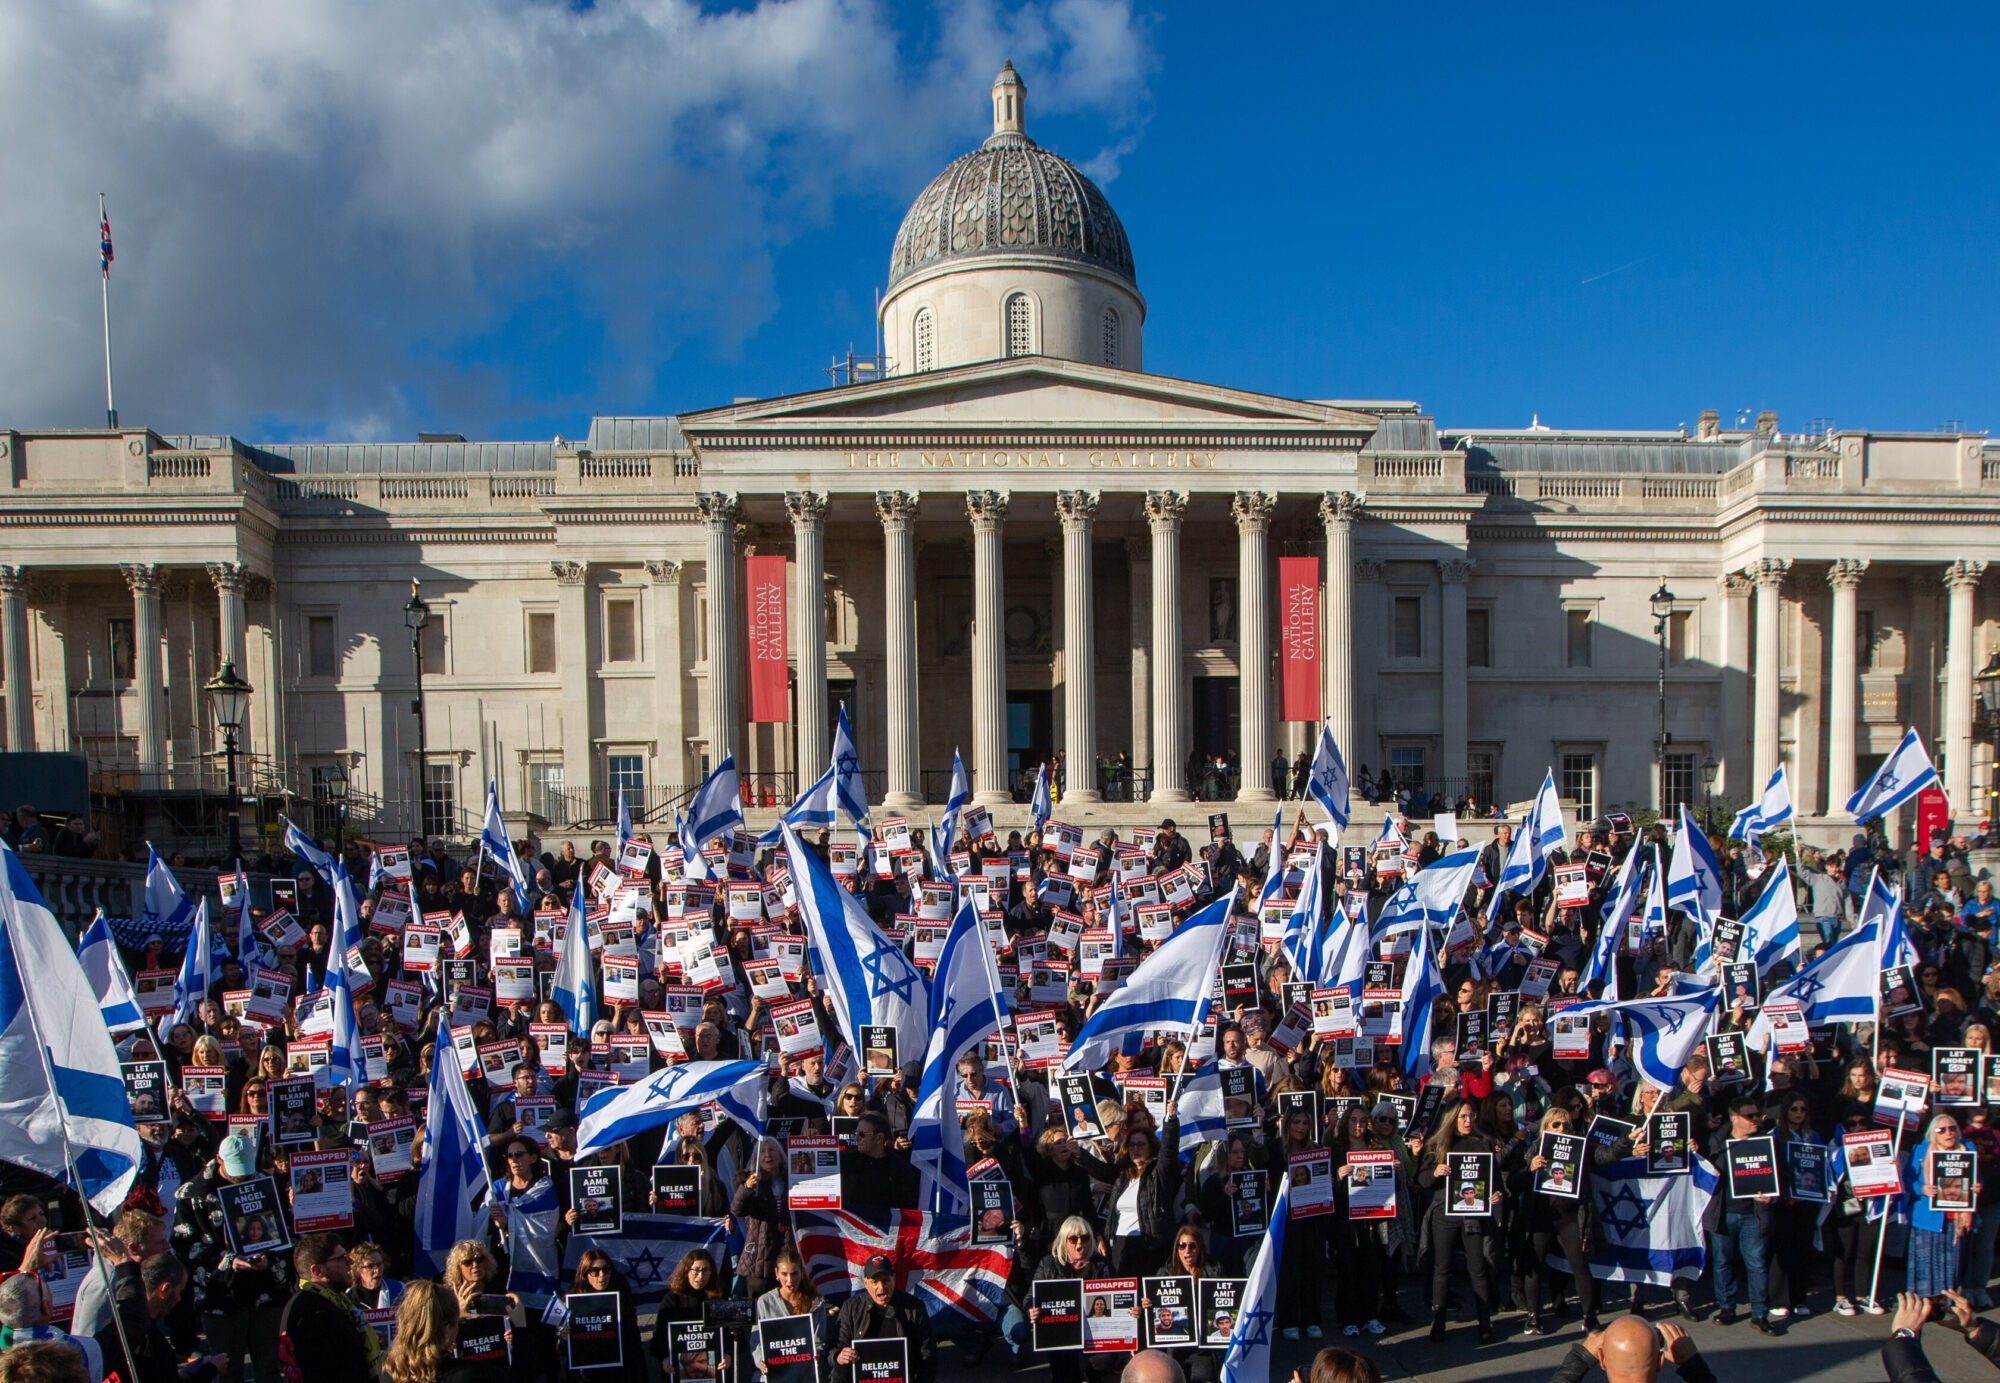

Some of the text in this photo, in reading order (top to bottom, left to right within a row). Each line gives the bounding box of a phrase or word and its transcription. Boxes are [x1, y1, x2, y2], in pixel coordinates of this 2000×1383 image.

[844, 451, 1218, 468] THE NATIONAL GALLERY
[756, 582, 768, 660] NATIONAL
[769, 583, 782, 661] GALLERY
[1290, 584, 1300, 660] NATIONAL
[1302, 584, 1314, 661] GALLERY
[1074, 847, 1099, 857] KIDNAPPED
[1160, 870, 1183, 884] KIDNAPPED
[1057, 912, 1084, 923] KIDNAPPED
[1522, 928, 1548, 942] KIDNAPPED
[1717, 926, 1739, 935] ELKANA
[605, 957, 637, 965] KIDNAPPED
[745, 960, 778, 969] KIDNAPPED
[258, 970, 290, 982] KIDNAPPED
[390, 980, 422, 992] KIDNAPPED
[460, 985, 491, 994] KIDNAPPED
[1312, 989, 1348, 998] KIDNAPPED
[773, 1002, 810, 1017] KIDNAPPED
[1018, 1013, 1053, 1023] KIDNAPPED
[480, 1042, 517, 1055] KIDNAPPED
[127, 1072, 158, 1080] ELKANA
[1885, 1069, 1928, 1084] KIDNAPPED
[1229, 1077, 1245, 1085] AMIT
[1067, 1085, 1083, 1094] ELIYA
[1231, 1085, 1245, 1093] GO!
[280, 1092, 310, 1101] ELKANA
[370, 1117, 412, 1131] KIDNAPPED
[1557, 1136, 1571, 1144] LET
[1846, 1133, 1888, 1143] KIDNAPPED
[1553, 1143, 1572, 1152] AMIT
[294, 1152, 346, 1163] KIDNAPPED
[1290, 1151, 1329, 1162] KIDNAPPED
[1554, 1151, 1569, 1159] GO!
[1736, 1155, 1768, 1164] RELEASE
[1794, 1152, 1820, 1160] ELKANA
[1735, 1168, 1772, 1177] HOSTAGES
[583, 1178, 608, 1186] AAMR
[1240, 1182, 1258, 1190] AAMR
[239, 1184, 255, 1194] LET
[234, 1192, 266, 1204] ANGEL
[1243, 1190, 1255, 1198] GO!
[244, 1202, 262, 1213] GO!
[1086, 1281, 1134, 1290] KIDNAPPED
[1162, 1296, 1179, 1305] GO!
[1216, 1298, 1233, 1306] GO!
[576, 1315, 612, 1324] RELEASE
[1039, 1315, 1079, 1323] HOSTAGES
[463, 1334, 500, 1348] RELEASE
[677, 1332, 714, 1341] ANDREY
[688, 1341, 706, 1350] GO!
[770, 1338, 806, 1349] RELEASE
[474, 1344, 491, 1353] THE
[780, 1346, 797, 1355] THE
[768, 1353, 811, 1365] HOSTAGES
[862, 1361, 899, 1371] RELEASE
[872, 1370, 889, 1378] THE
